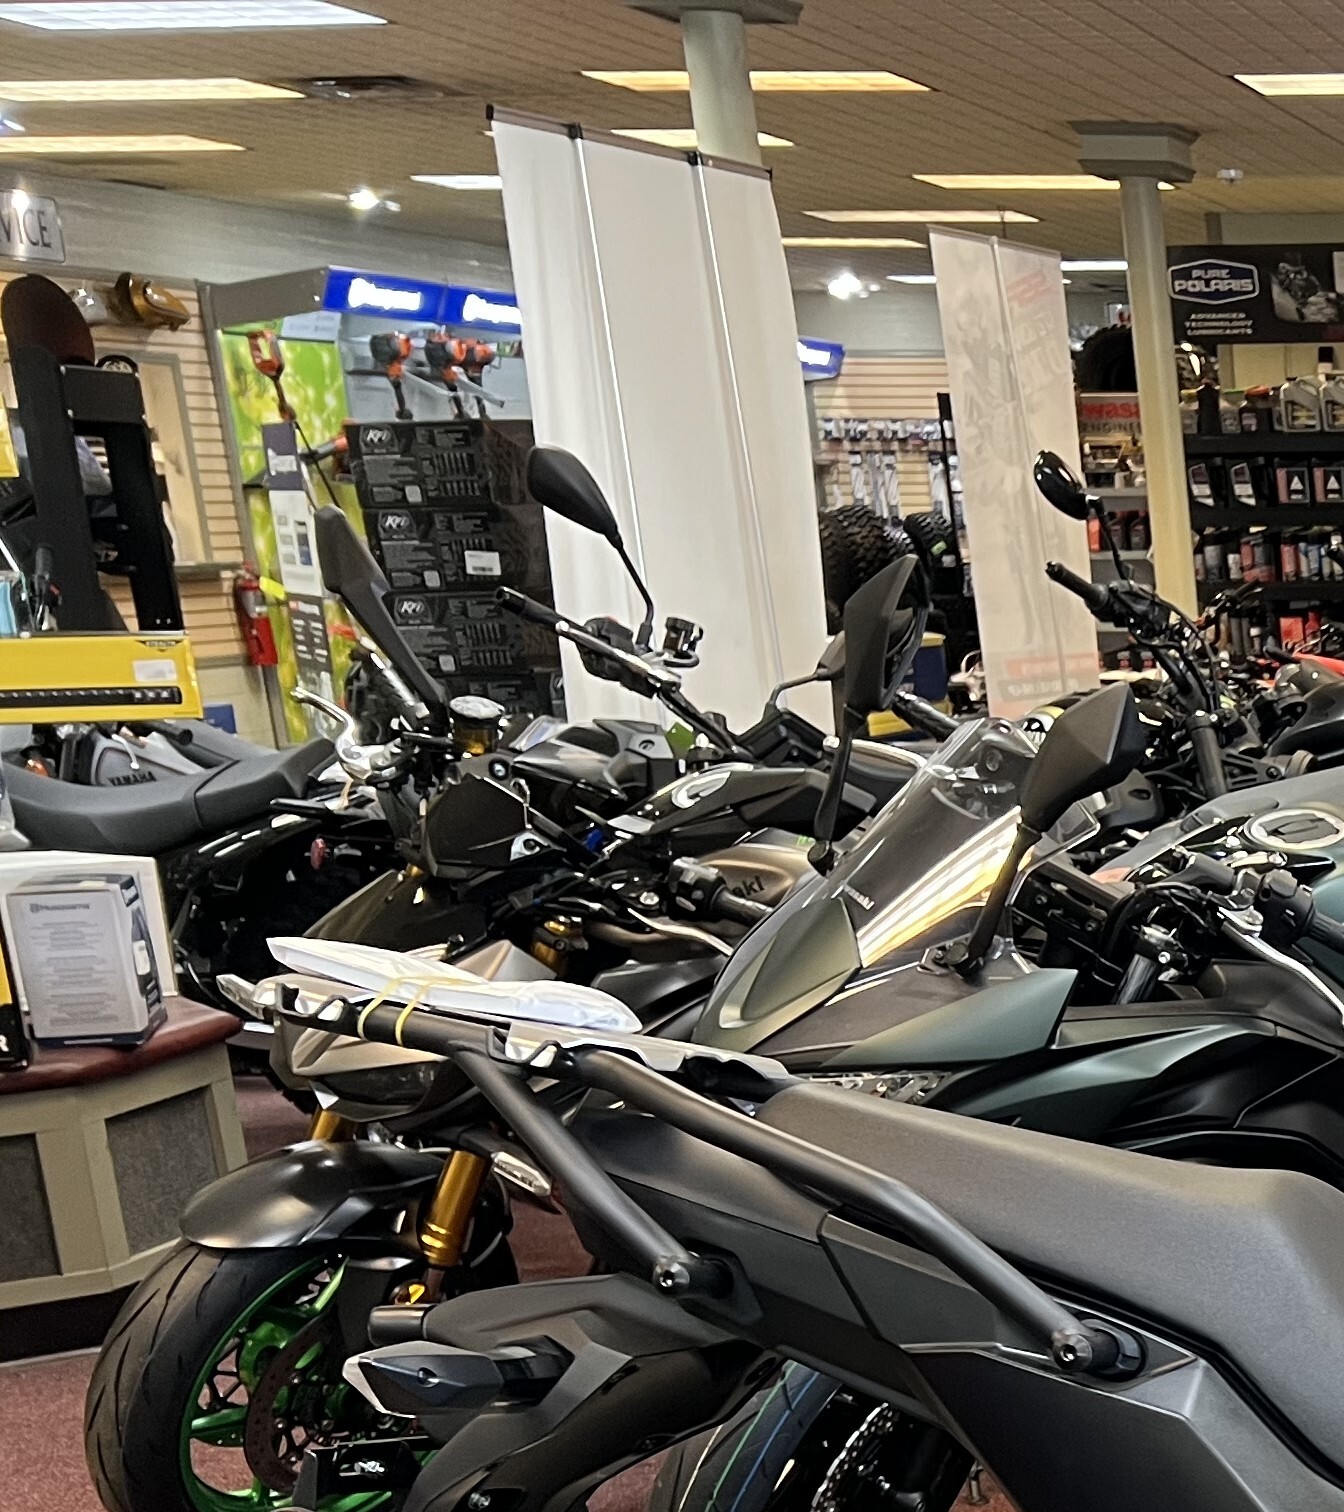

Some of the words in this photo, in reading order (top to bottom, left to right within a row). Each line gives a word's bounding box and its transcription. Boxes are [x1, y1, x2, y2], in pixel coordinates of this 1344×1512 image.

[1191, 269, 1231, 279] PURE
[1174, 279, 1254, 293] POLARIS
[107, 771, 157, 786] YAMAHA
